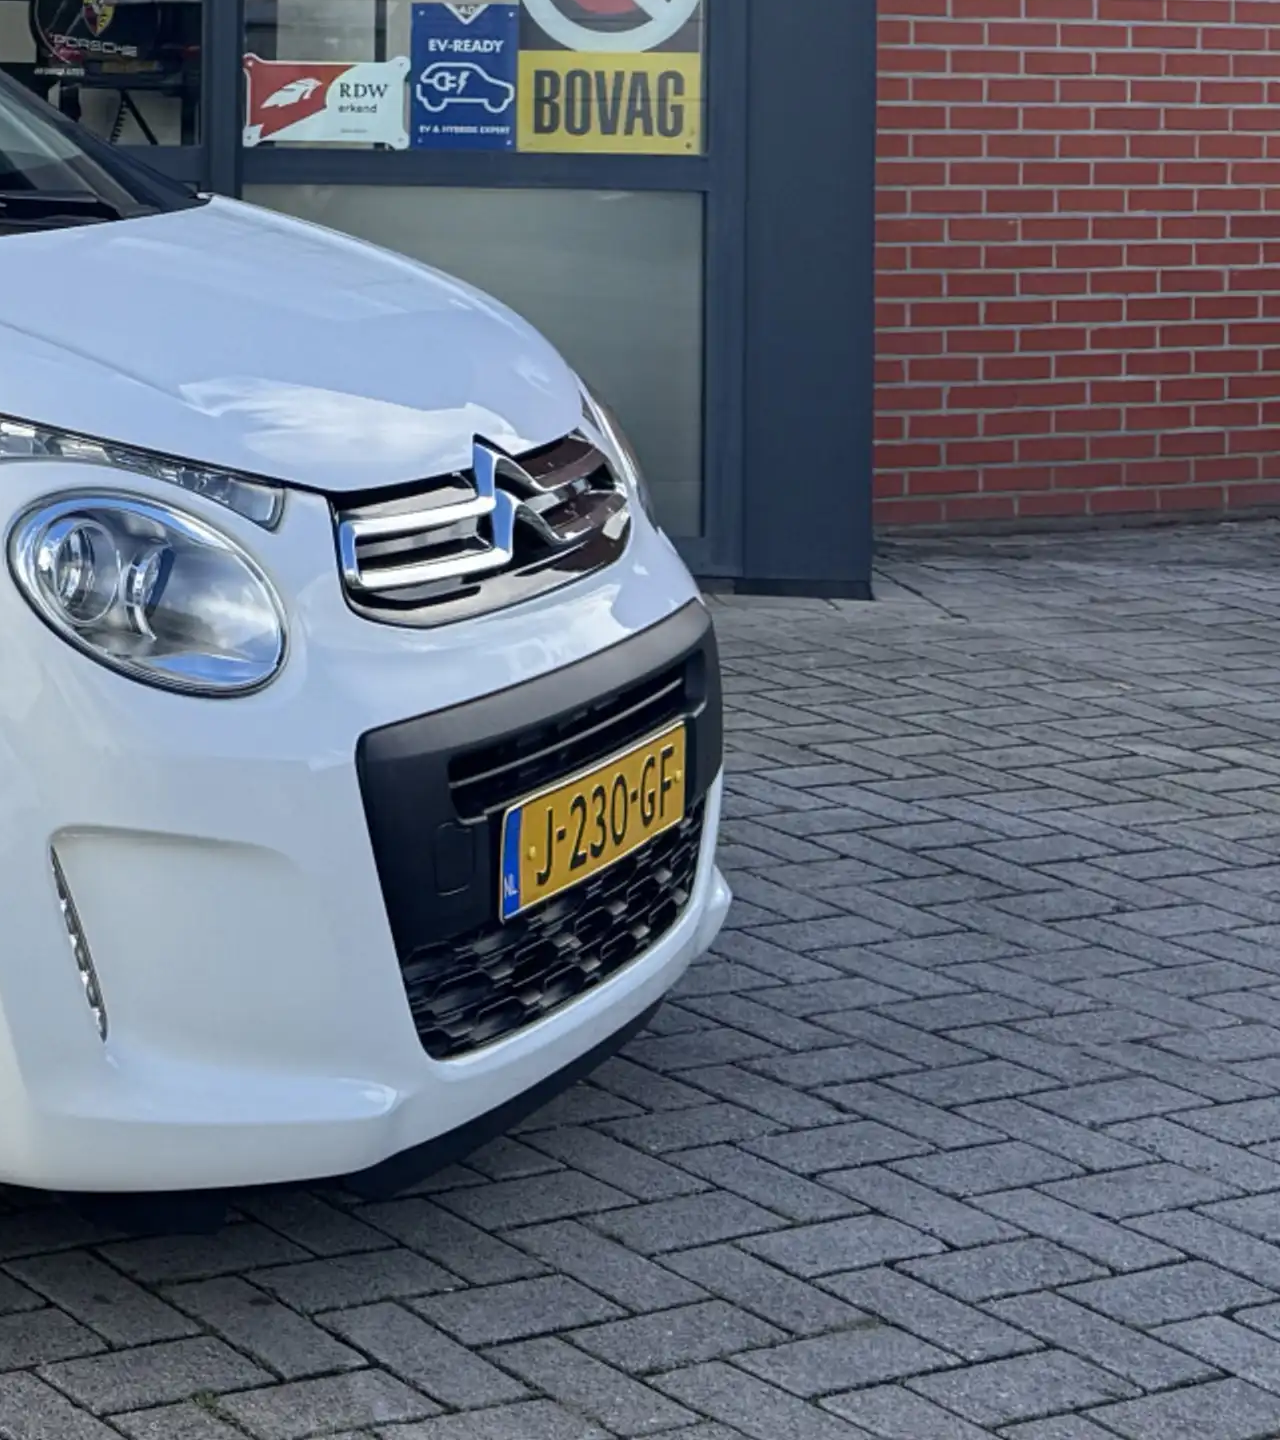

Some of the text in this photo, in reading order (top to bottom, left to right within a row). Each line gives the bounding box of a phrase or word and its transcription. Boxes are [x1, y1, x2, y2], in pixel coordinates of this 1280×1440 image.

[428, 38, 505, 53] EV-READY
[339, 82, 390, 98] RDW
[338, 103, 378, 114] erkend
[534, 68, 685, 137] BOVAG
[536, 744, 675, 887] J-230-GF
[504, 873, 519, 899] NL
